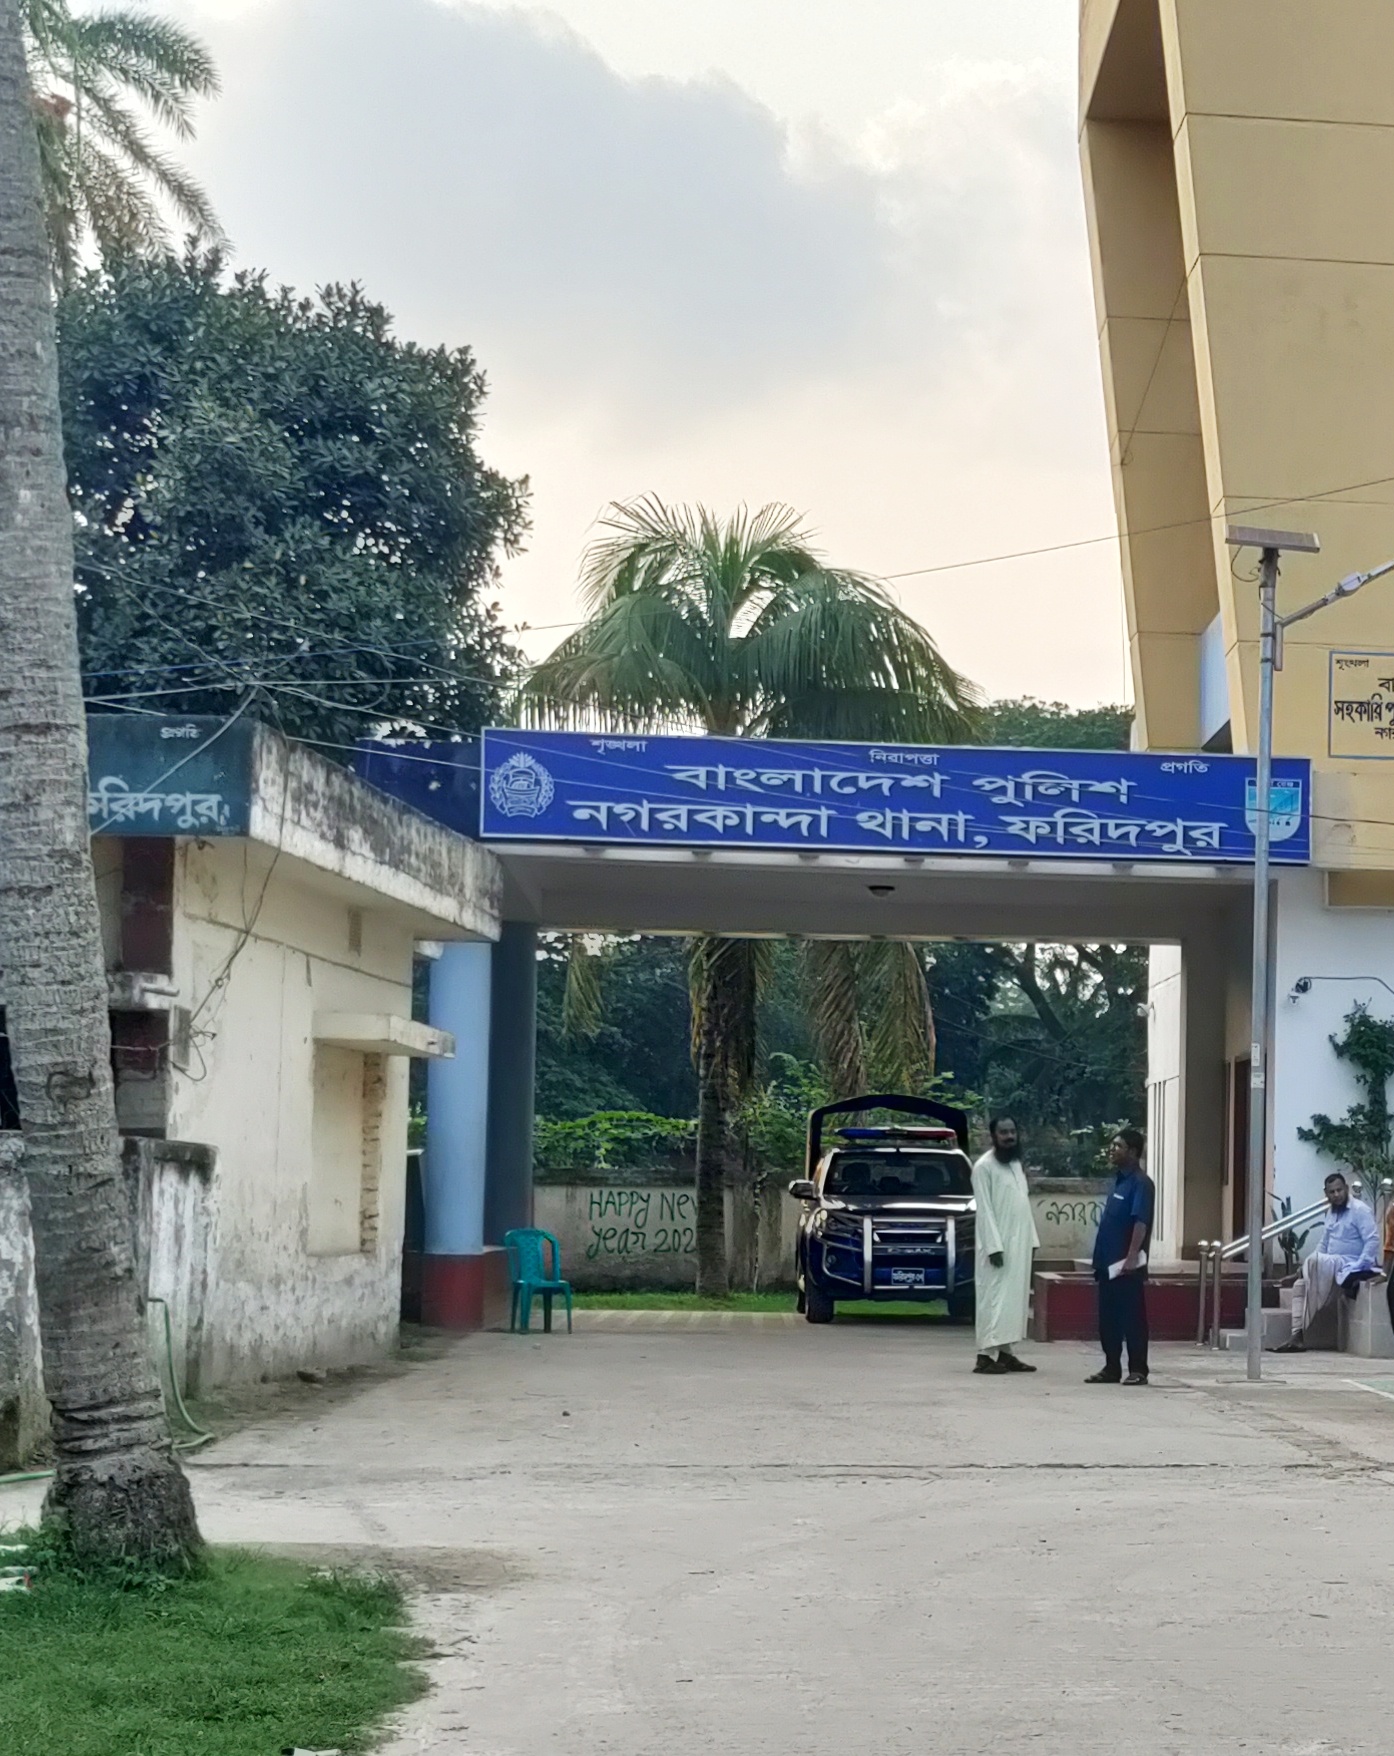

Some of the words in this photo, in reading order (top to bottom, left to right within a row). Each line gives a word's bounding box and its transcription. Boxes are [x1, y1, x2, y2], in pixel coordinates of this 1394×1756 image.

[1334, 692, 1384, 723] সহকারি
[868, 749, 940, 766] নিরাপত্তা
[1160, 760, 1210, 774] প্রগতি
[664, 763, 951, 799] বাংলাদেশ
[972, 770, 1138, 807] পুলিশ
[566, 798, 838, 838] নগরকান্দা
[855, 806, 989, 849] থানা,
[998, 808, 1228, 855] ফরিদপুর
